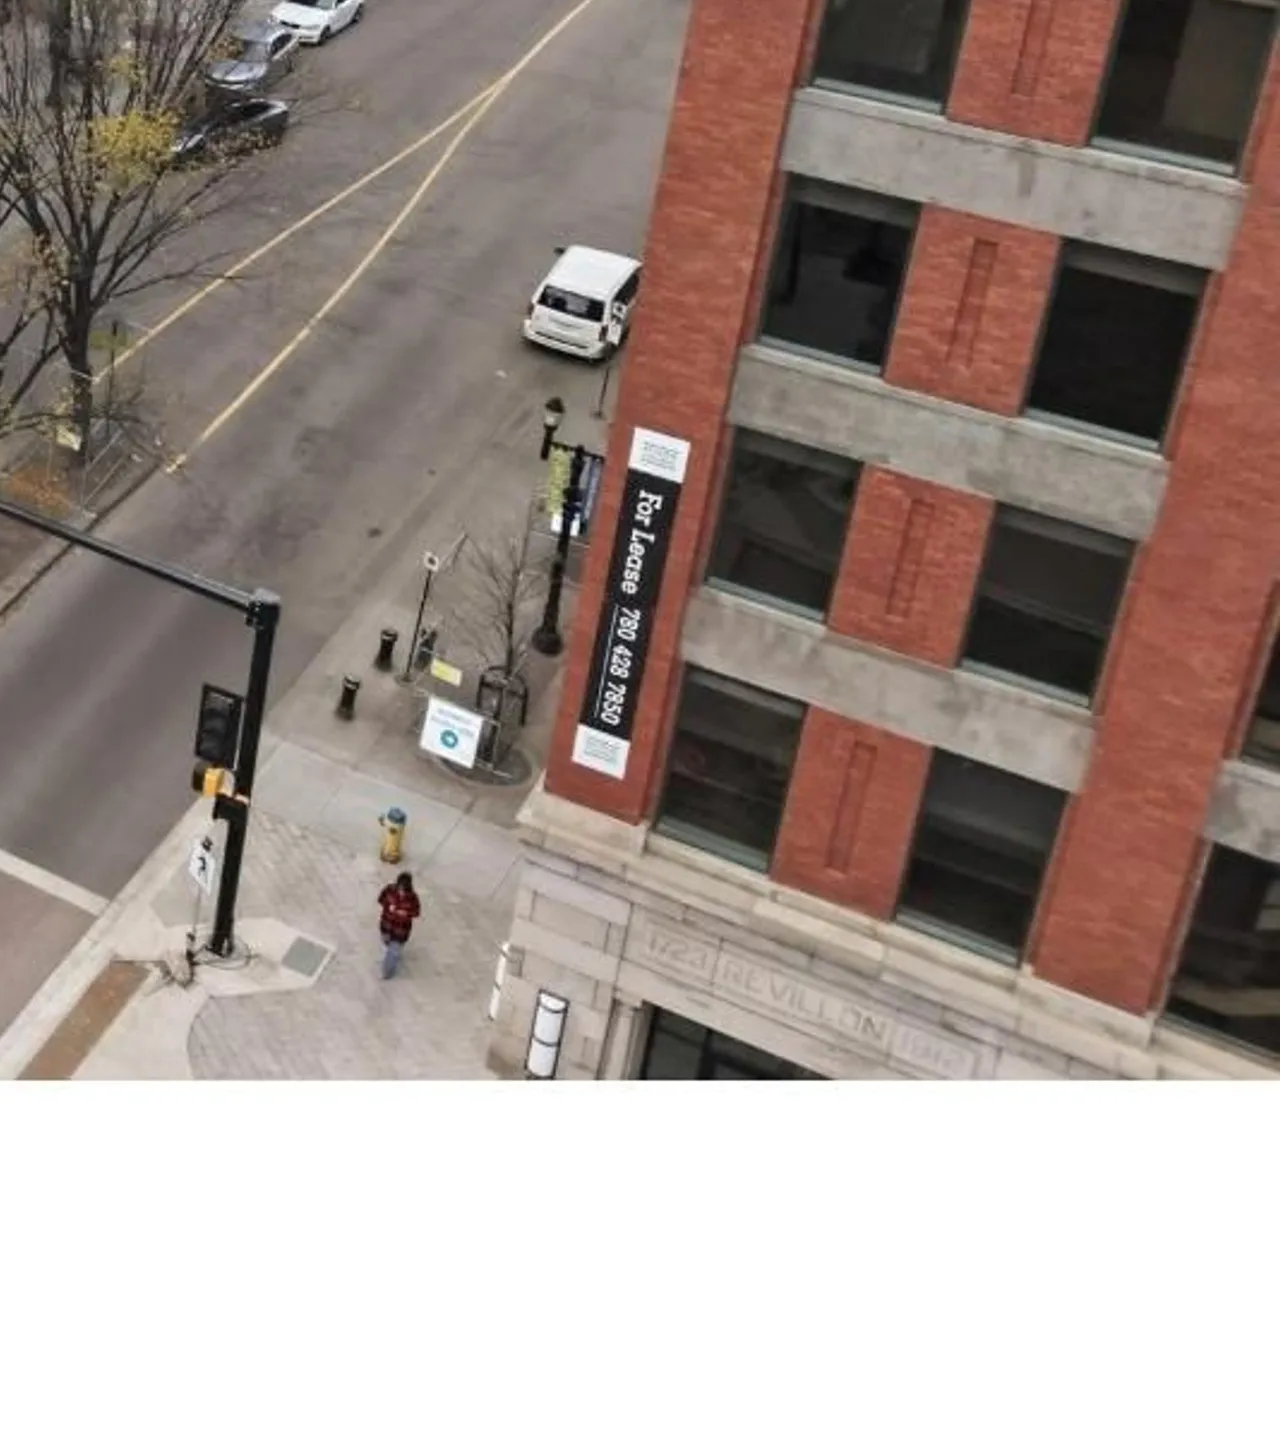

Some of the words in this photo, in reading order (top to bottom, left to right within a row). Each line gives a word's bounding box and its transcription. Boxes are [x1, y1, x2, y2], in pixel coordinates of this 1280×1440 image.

[634, 488, 663, 526] For
[620, 527, 656, 596] Lease
[616, 605, 641, 642] 780
[609, 642, 634, 679] 428
[600, 679, 628, 727] 7850
